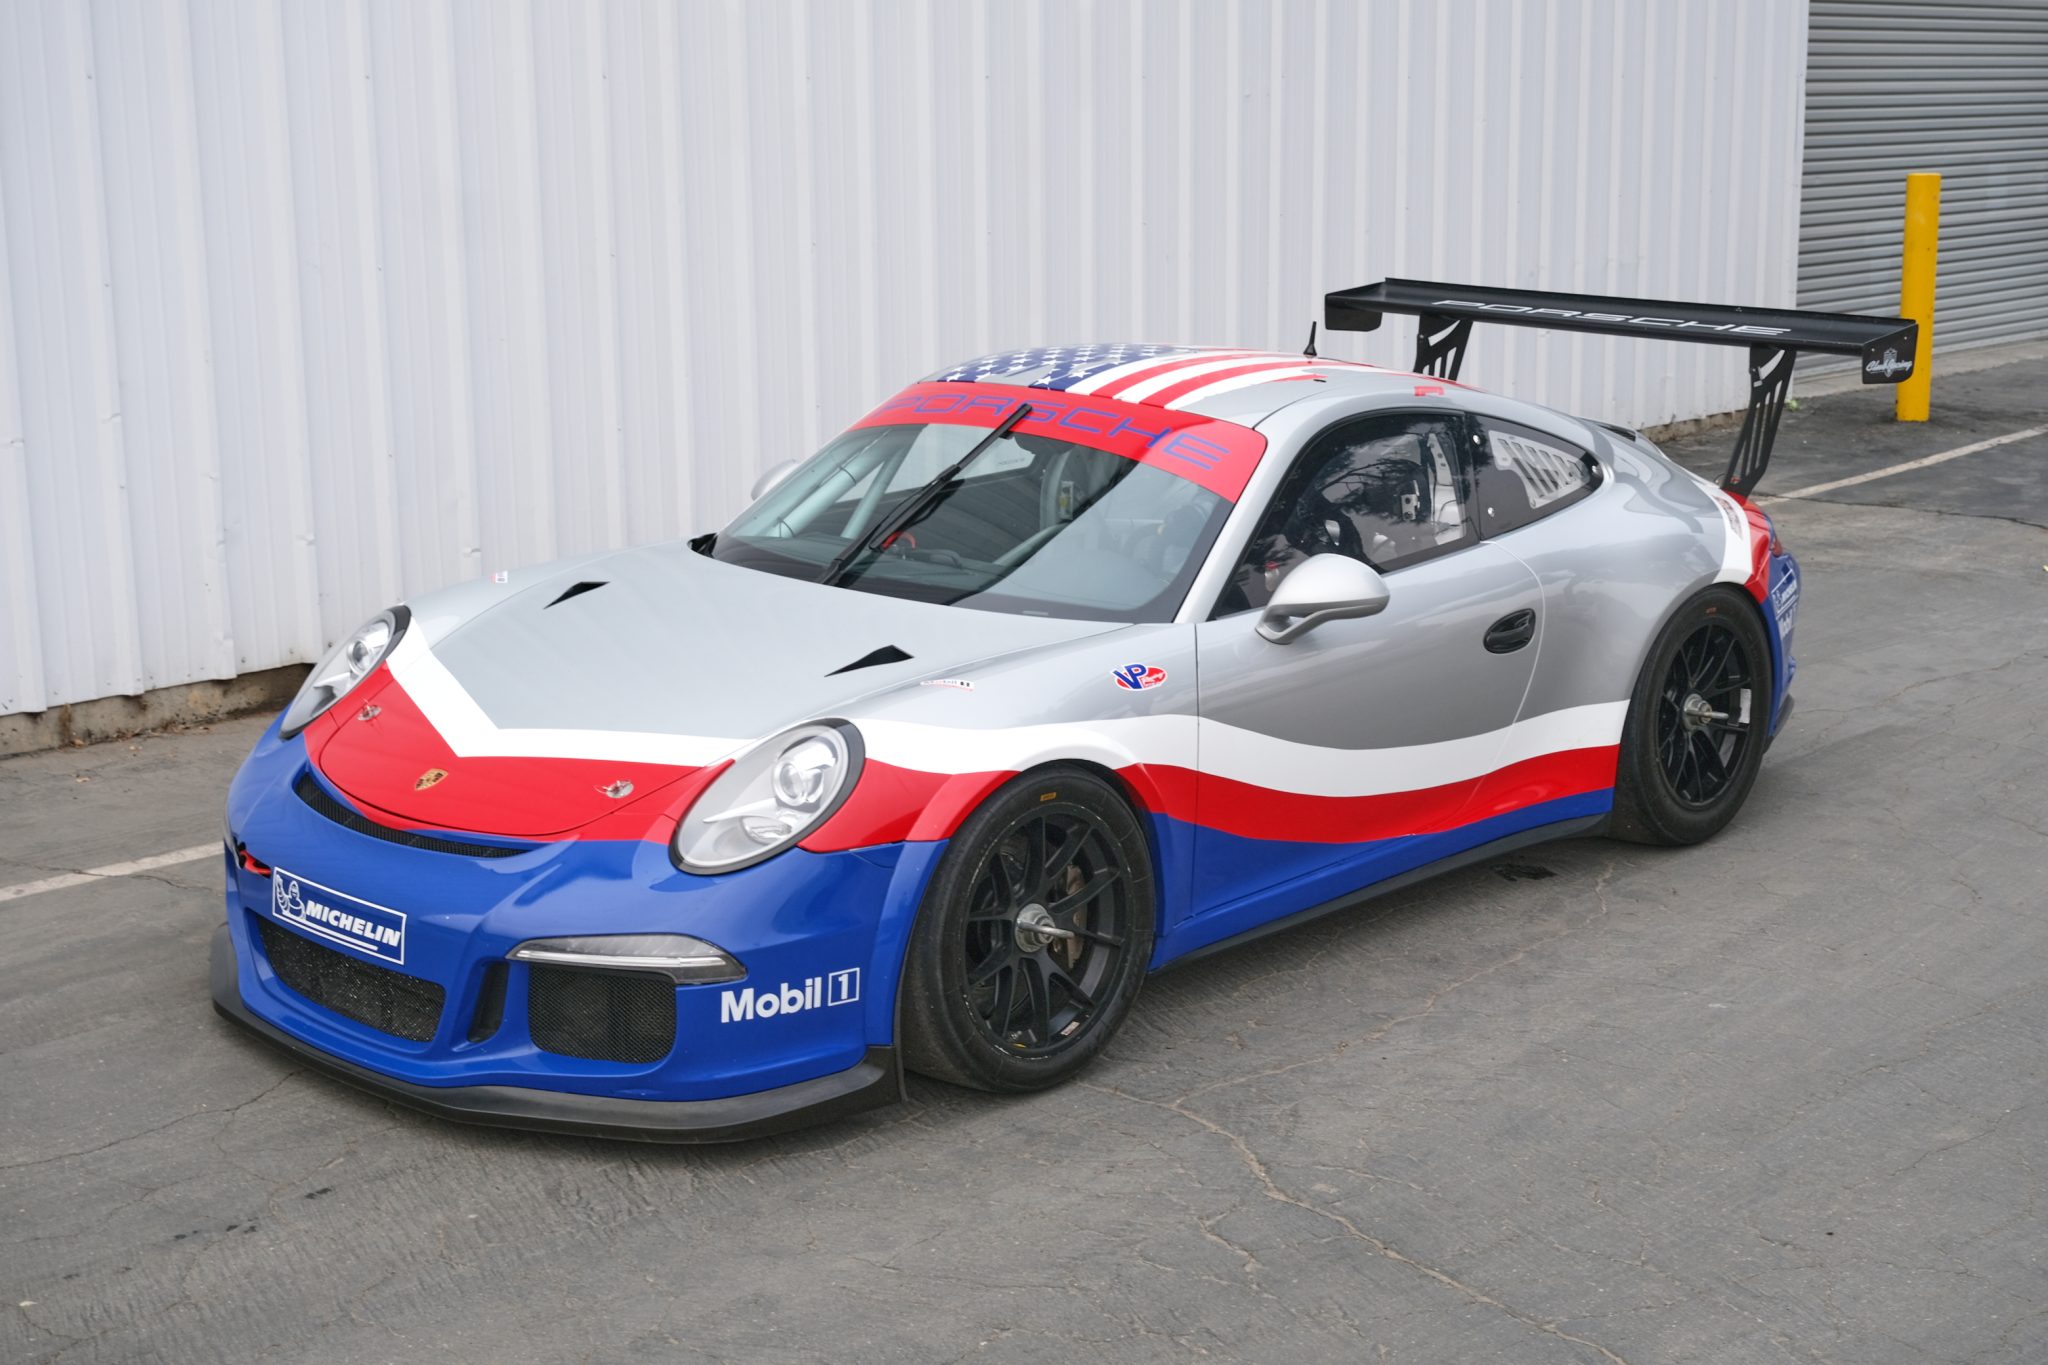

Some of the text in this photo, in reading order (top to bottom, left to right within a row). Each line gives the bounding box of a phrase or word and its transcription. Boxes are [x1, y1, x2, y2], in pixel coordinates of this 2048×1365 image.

[1432, 299, 1792, 336] PORSCHE
[874, 393, 1230, 470] PORSCHE
[1113, 663, 1147, 689] VP
[306, 900, 401, 947] MICHELIN
[721, 973, 849, 1023] Mobil 1
